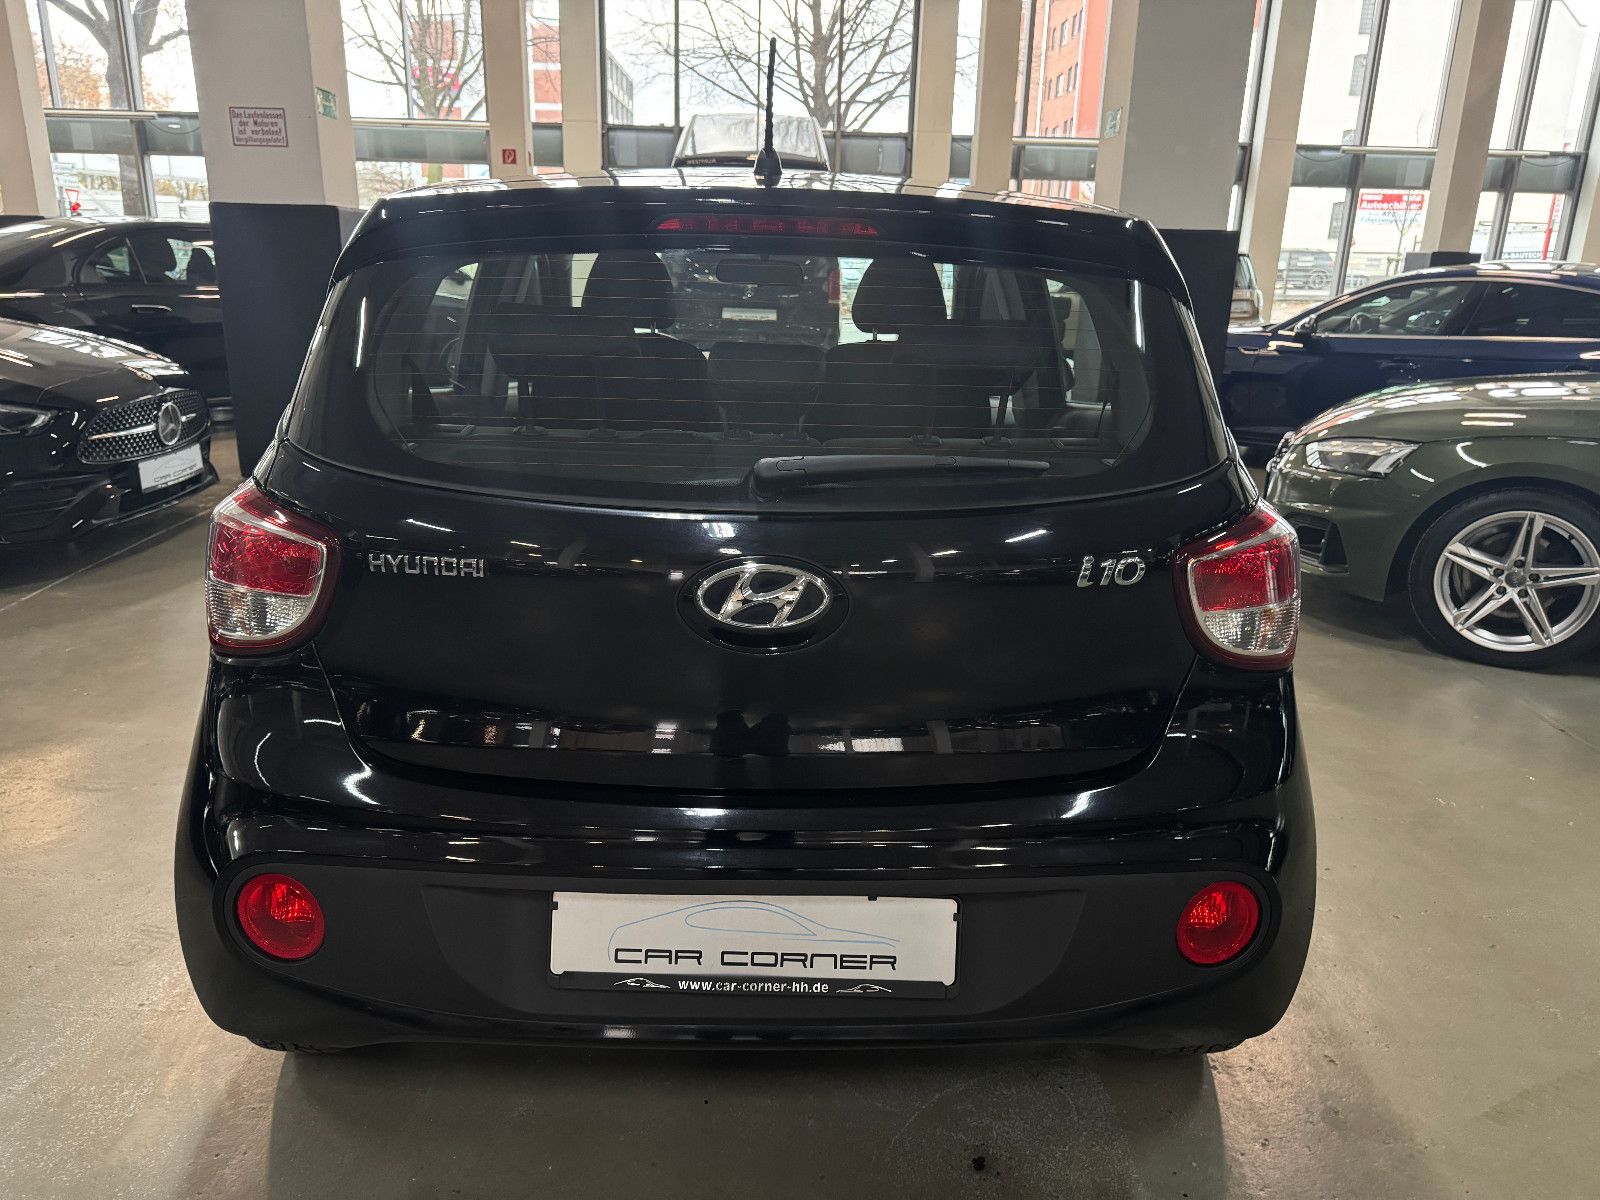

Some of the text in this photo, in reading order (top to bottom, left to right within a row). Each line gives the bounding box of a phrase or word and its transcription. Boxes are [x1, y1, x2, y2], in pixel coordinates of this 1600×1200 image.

[368, 553, 485, 578] HYUNDAI
[1077, 555, 1146, 588] i10
[614, 948, 898, 971] CAR CORNER
[677, 979, 830, 994] www.car-corner-hh.de
